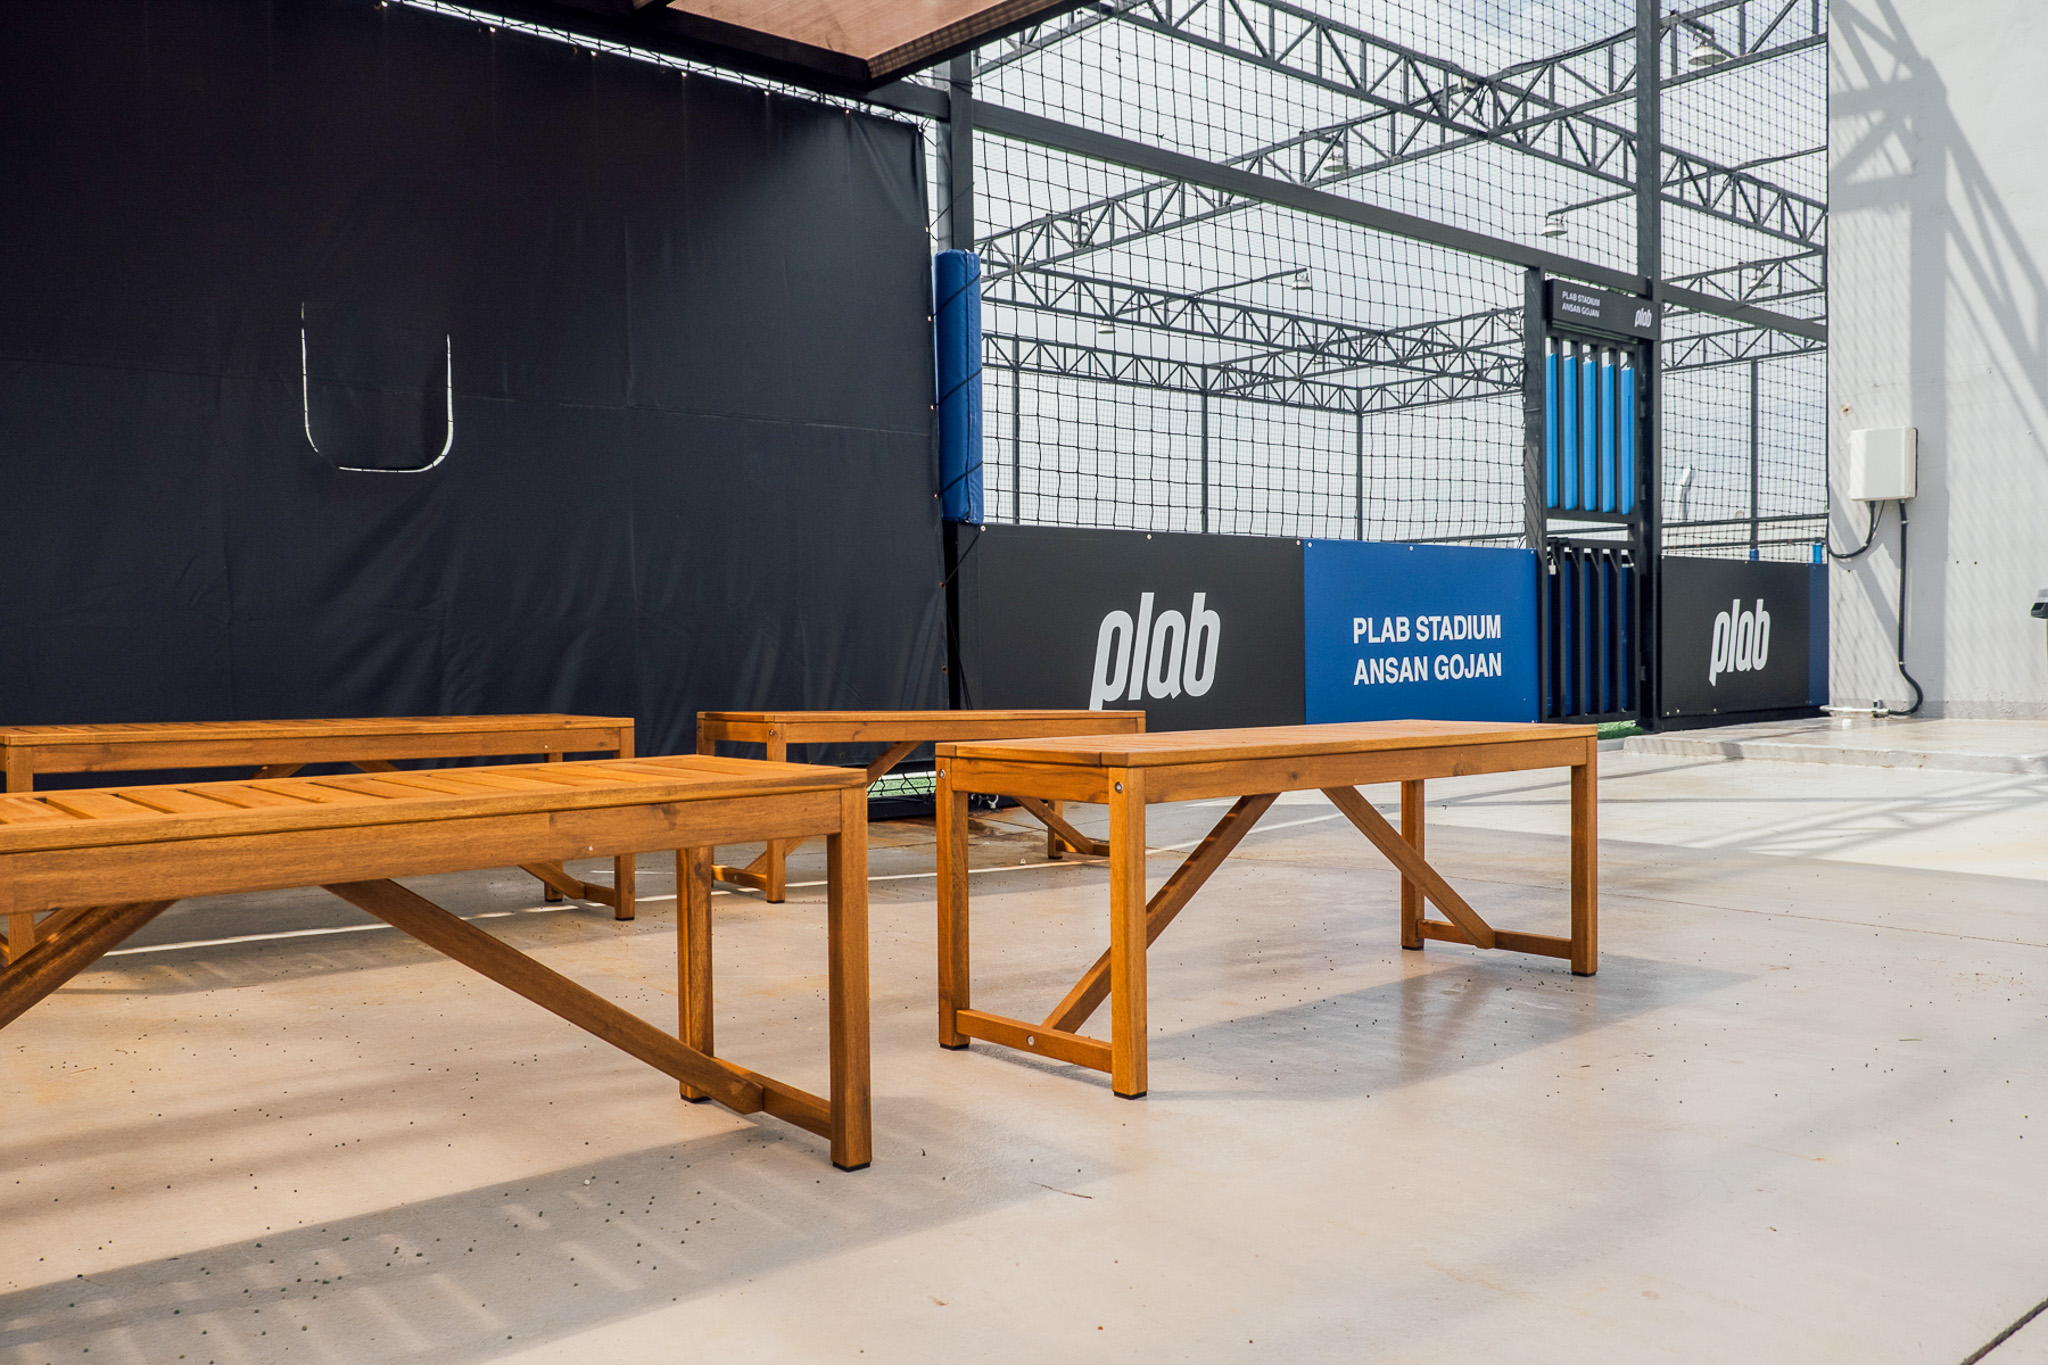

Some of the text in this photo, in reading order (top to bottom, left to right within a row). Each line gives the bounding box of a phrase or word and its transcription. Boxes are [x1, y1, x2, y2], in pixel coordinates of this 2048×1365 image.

[1562, 291, 1600, 307] PLAB STADIUM
[1562, 303, 1600, 318] ANSAN GOJAN
[1634, 307, 1652, 328] plab
[1353, 614, 1501, 643] PLAB STADIUM
[1709, 598, 1770, 686] plab
[1089, 592, 1221, 710] plab
[1353, 652, 1502, 685] ANSAN GOJAN
